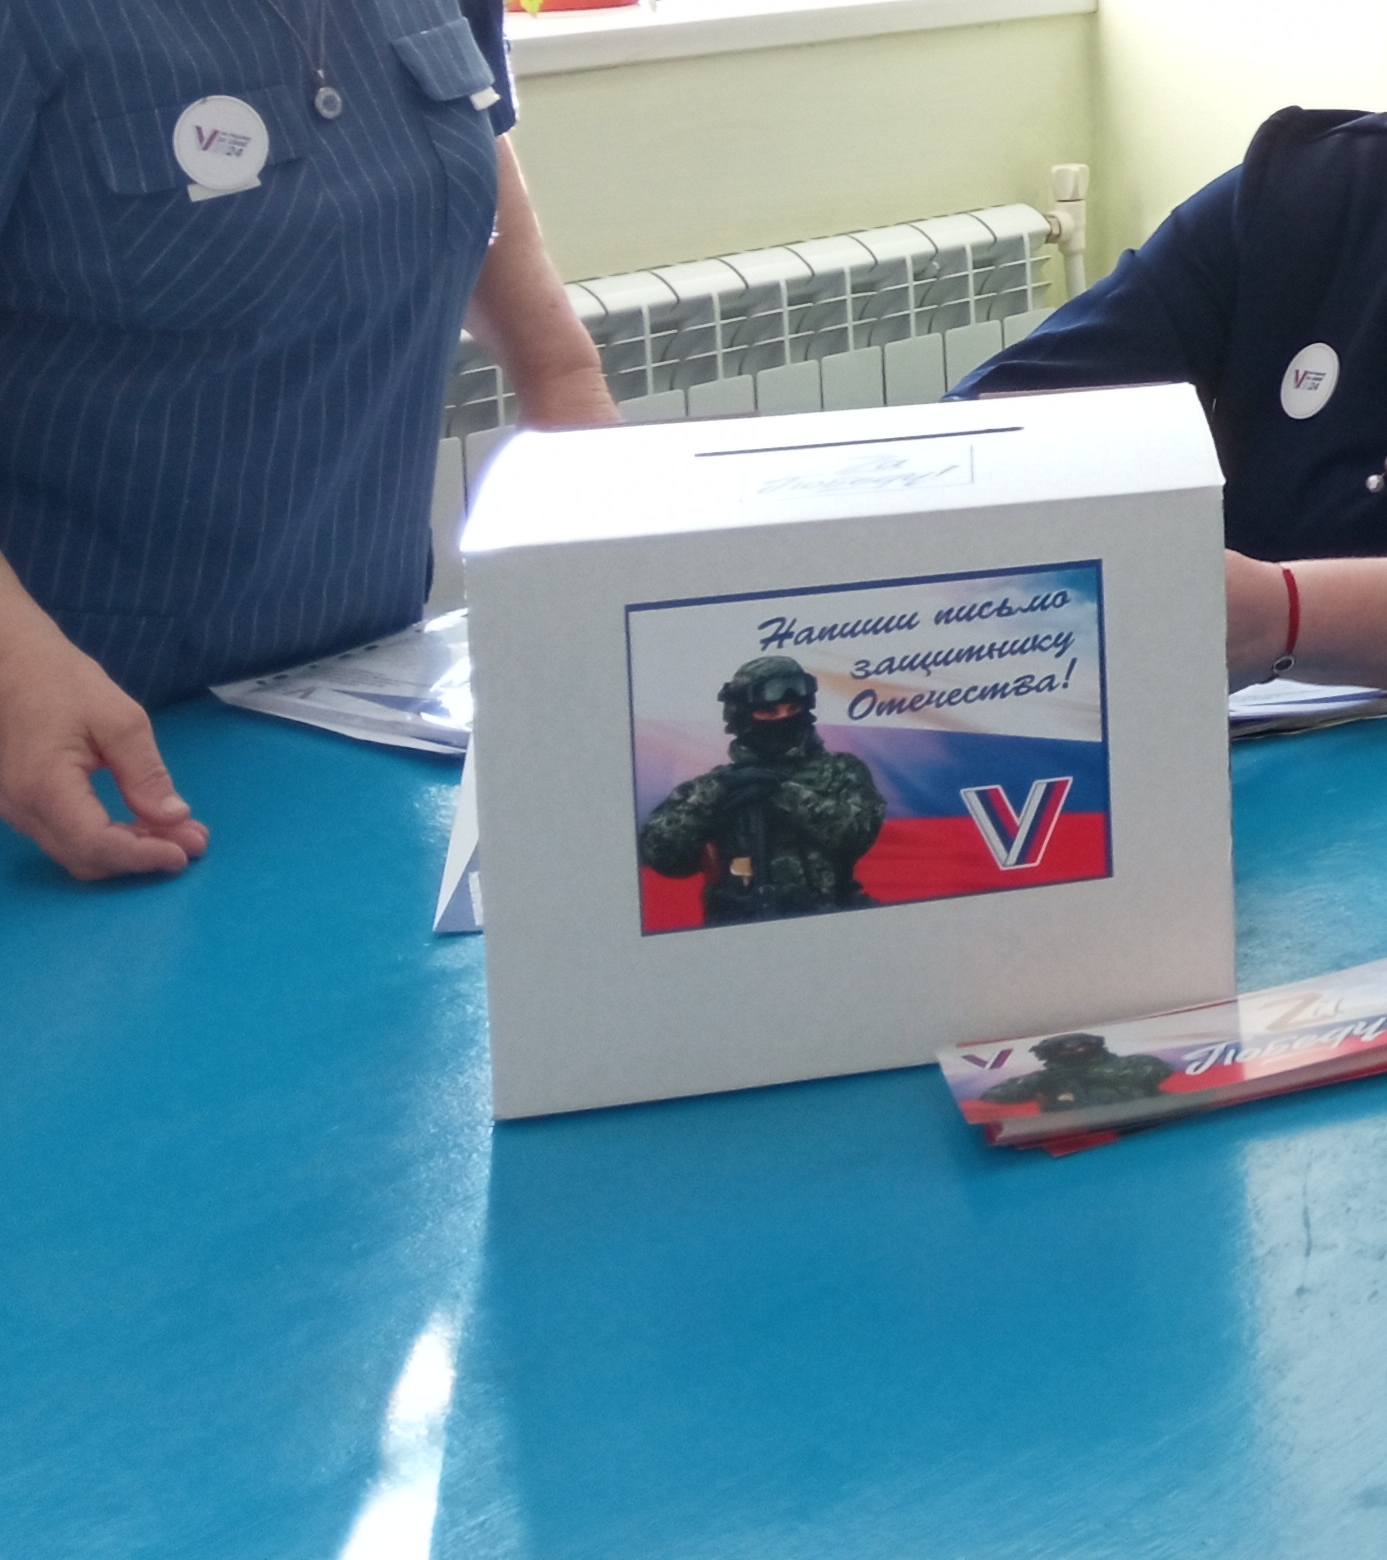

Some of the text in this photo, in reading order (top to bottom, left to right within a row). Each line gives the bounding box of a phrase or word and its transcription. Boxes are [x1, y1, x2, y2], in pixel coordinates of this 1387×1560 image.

[756, 588, 1071, 652] Напиши письмо
[849, 627, 1076, 681] защитнику
[847, 658, 1078, 722] Отечества!
